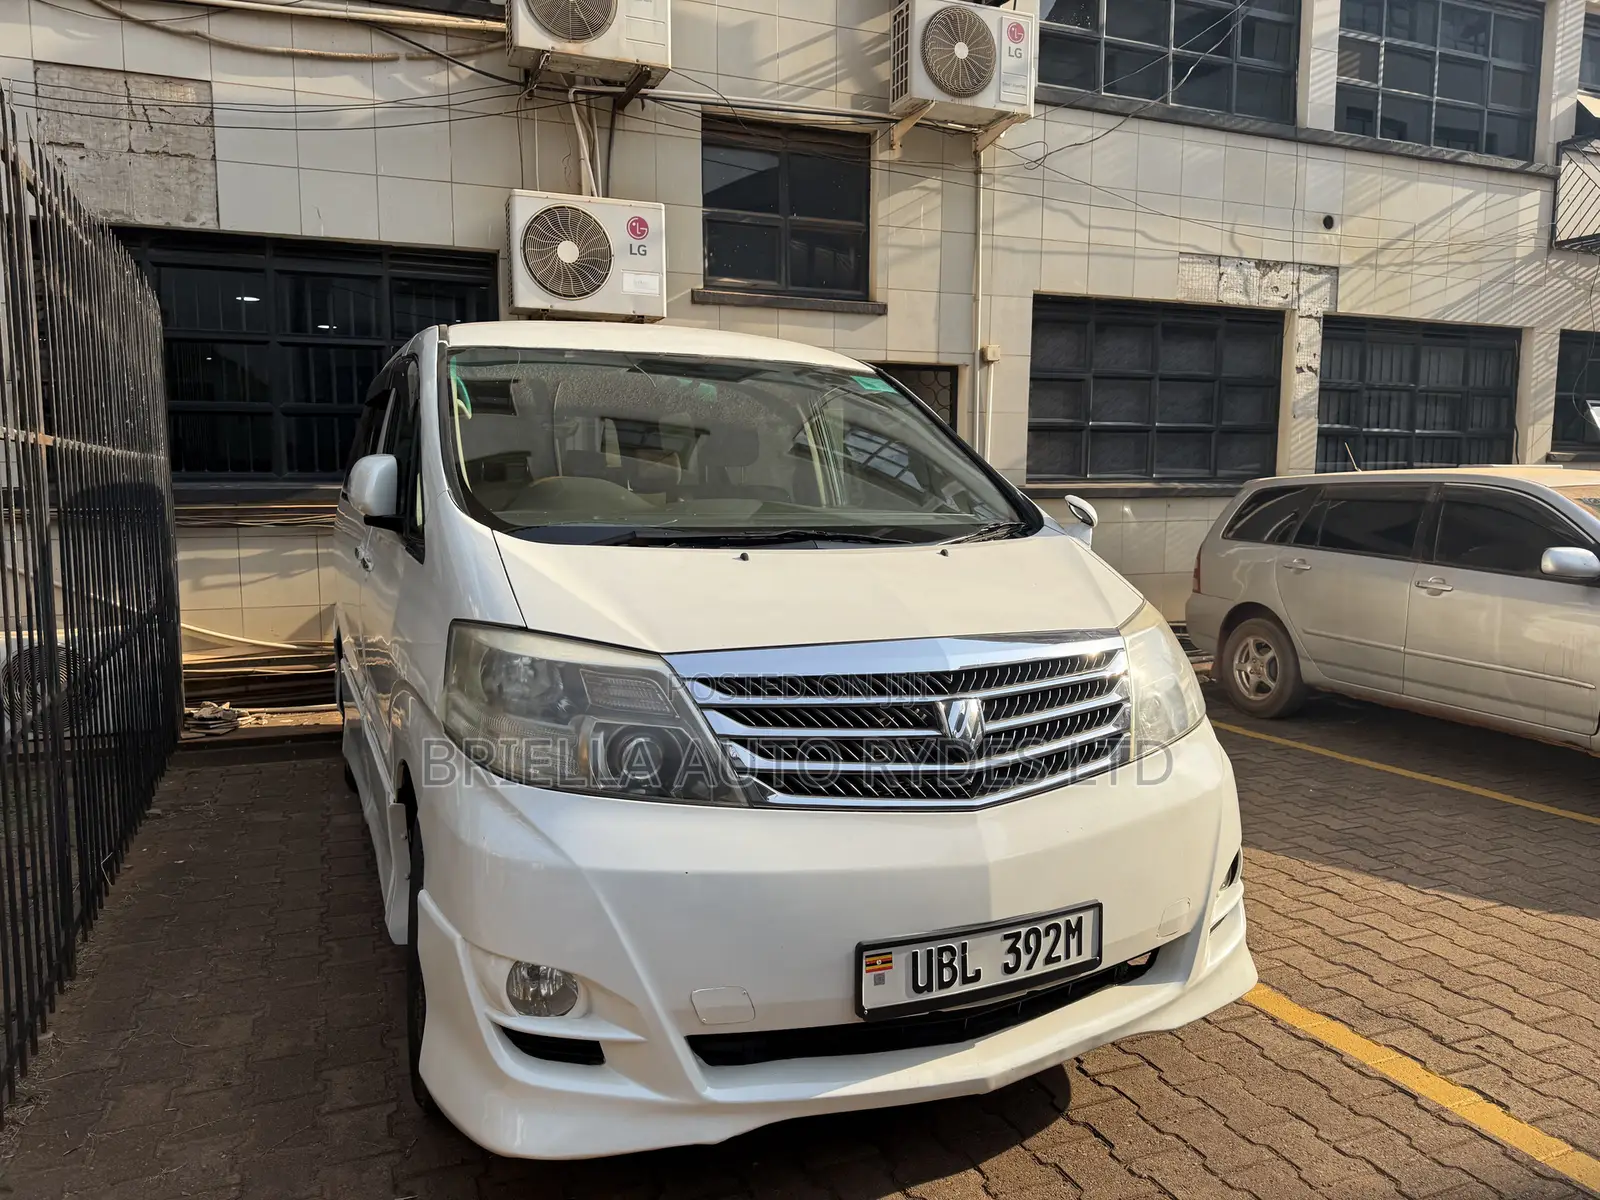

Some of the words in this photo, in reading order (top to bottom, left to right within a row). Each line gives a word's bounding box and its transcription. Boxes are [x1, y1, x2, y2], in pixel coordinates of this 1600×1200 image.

[1008, 46, 1023, 58] LG
[629, 243, 648, 256] LG
[911, 941, 982, 994] UBL
[1002, 915, 1083, 975] 392M
